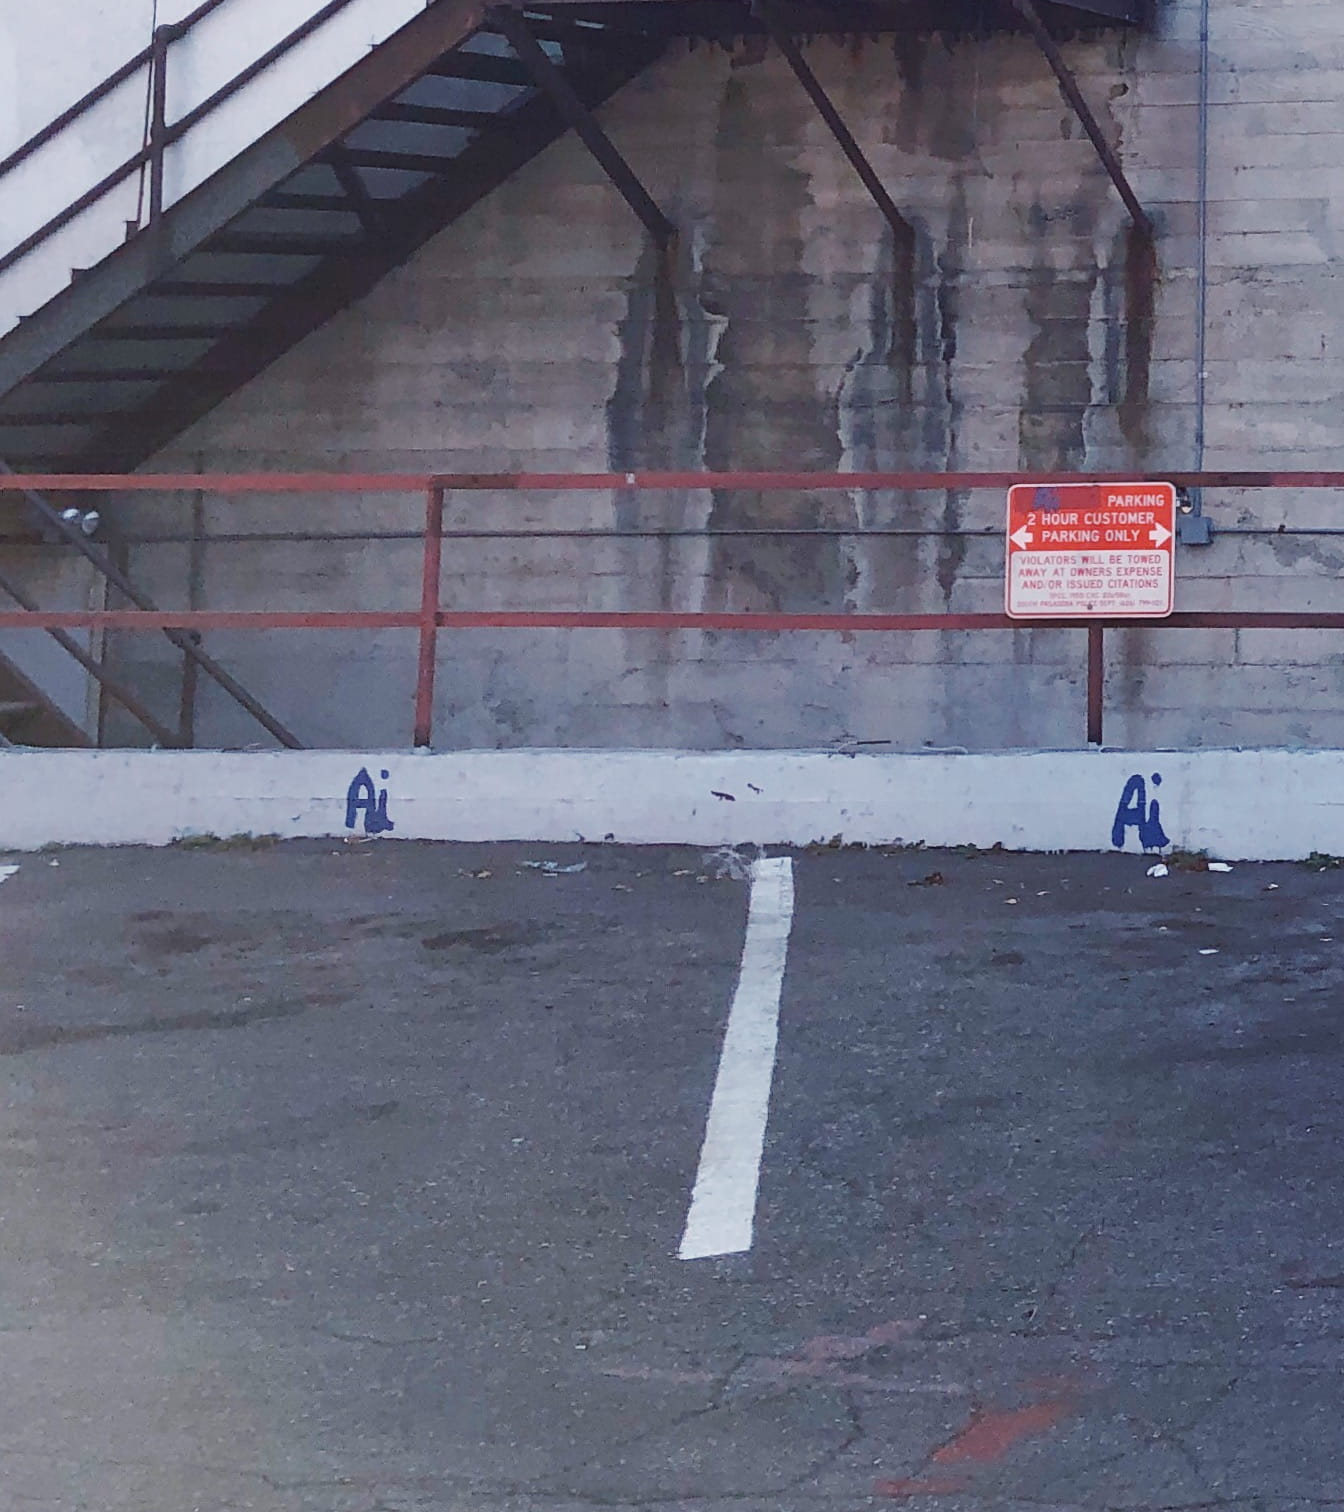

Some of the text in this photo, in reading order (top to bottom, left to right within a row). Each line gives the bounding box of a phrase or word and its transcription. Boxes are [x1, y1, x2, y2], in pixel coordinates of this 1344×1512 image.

[1107, 494, 1165, 507] PARKING
[1027, 511, 1154, 526] 2 HOUR CUSTOMER
[1041, 529, 1140, 543] PARKING ONLY
[1020, 554, 1161, 565] VIOLATORS WILL BE TOWED
[1018, 566, 1163, 577] AWAY AT OWNERS EXPENSE
[1067, 579, 1103, 589] ISSUED
[1108, 578, 1158, 589] CITATIONS
[345, 766, 395, 834] Ai
[1110, 772, 1171, 855] Ai
